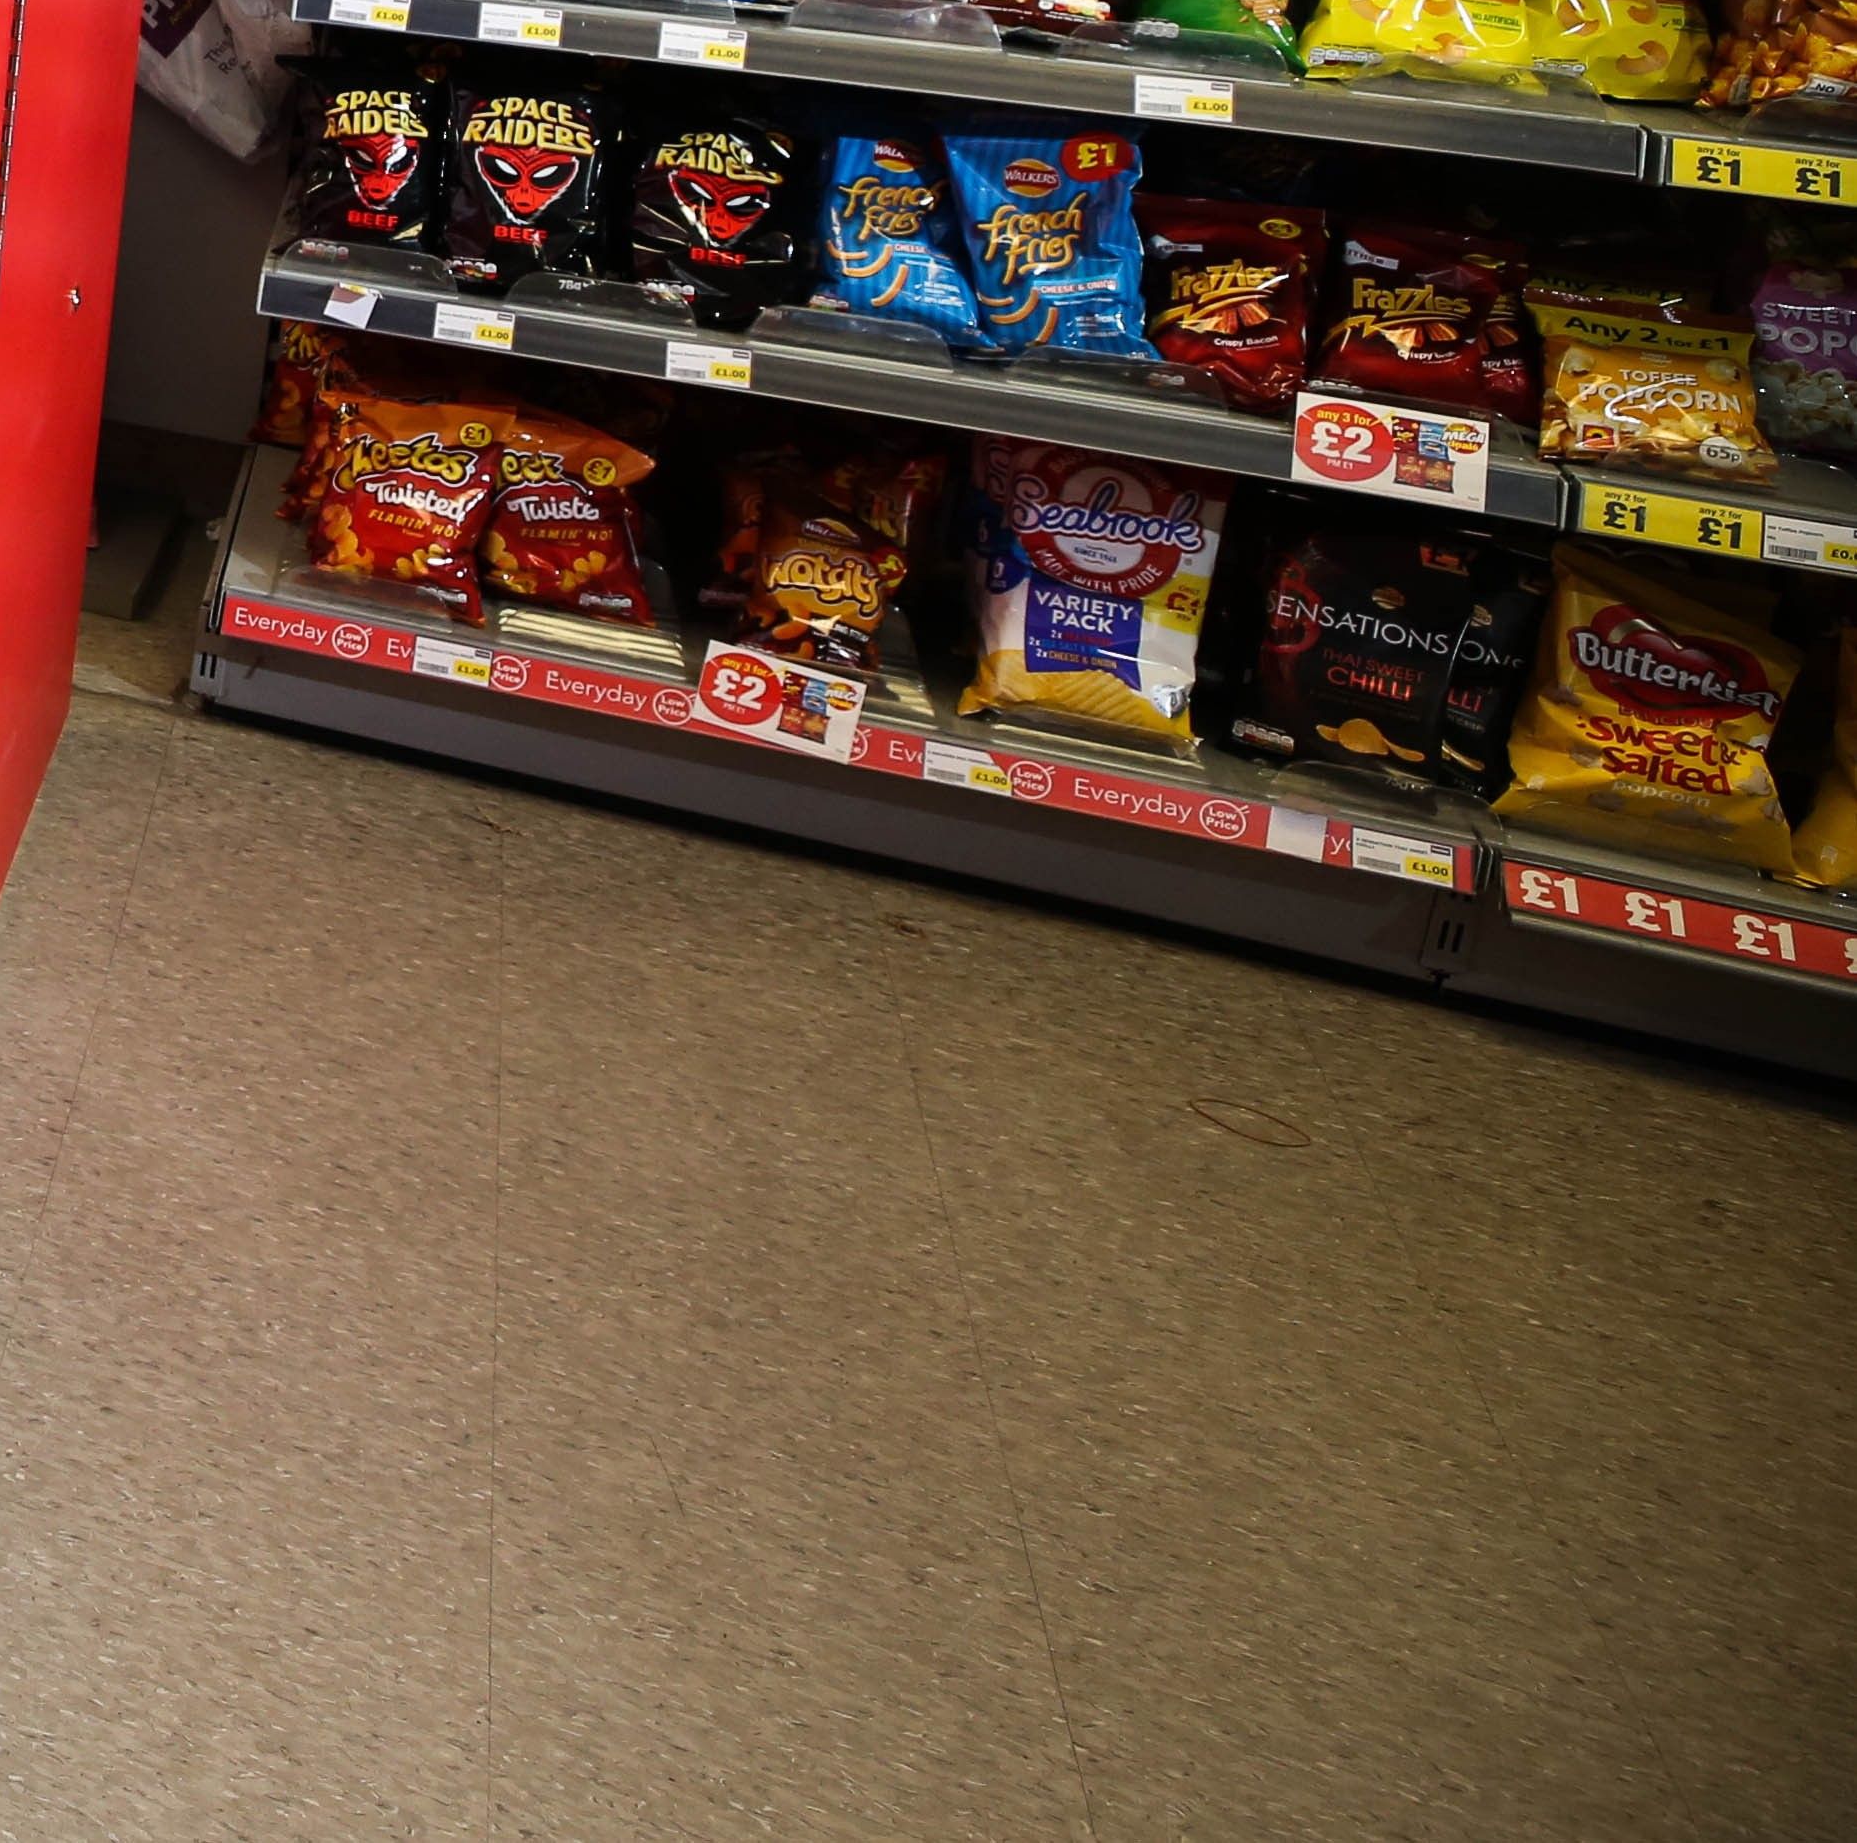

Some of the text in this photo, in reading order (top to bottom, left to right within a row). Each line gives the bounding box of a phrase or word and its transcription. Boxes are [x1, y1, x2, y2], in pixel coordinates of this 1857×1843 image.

[489, 97, 574, 124] SPACE
[462, 119, 594, 154] RAIDERS
[1698, 157, 1743, 187] £1
[1353, 280, 1471, 316] Frazzles
[1579, 383, 1740, 413] POPCORN
[1317, 408, 1373, 425] any 3 for
[1311, 429, 1373, 461] £2
[1706, 444, 1740, 463] 65p
[1012, 476, 1203, 550] Seabrook
[1602, 502, 1647, 534] £1
[1034, 591, 1134, 622] VARIETY
[1051, 609, 1113, 635] PACK
[234, 607, 327, 645] Everyday
[340, 629, 363, 644] Low
[1266, 593, 1449, 654] SENSATIONS
[337, 639, 365, 655] Price
[1579, 631, 1781, 716] Butterkist
[1585, 716, 1713, 758] Sweet
[1602, 745, 1732, 796] salted
[1520, 869, 1581, 917] £1
